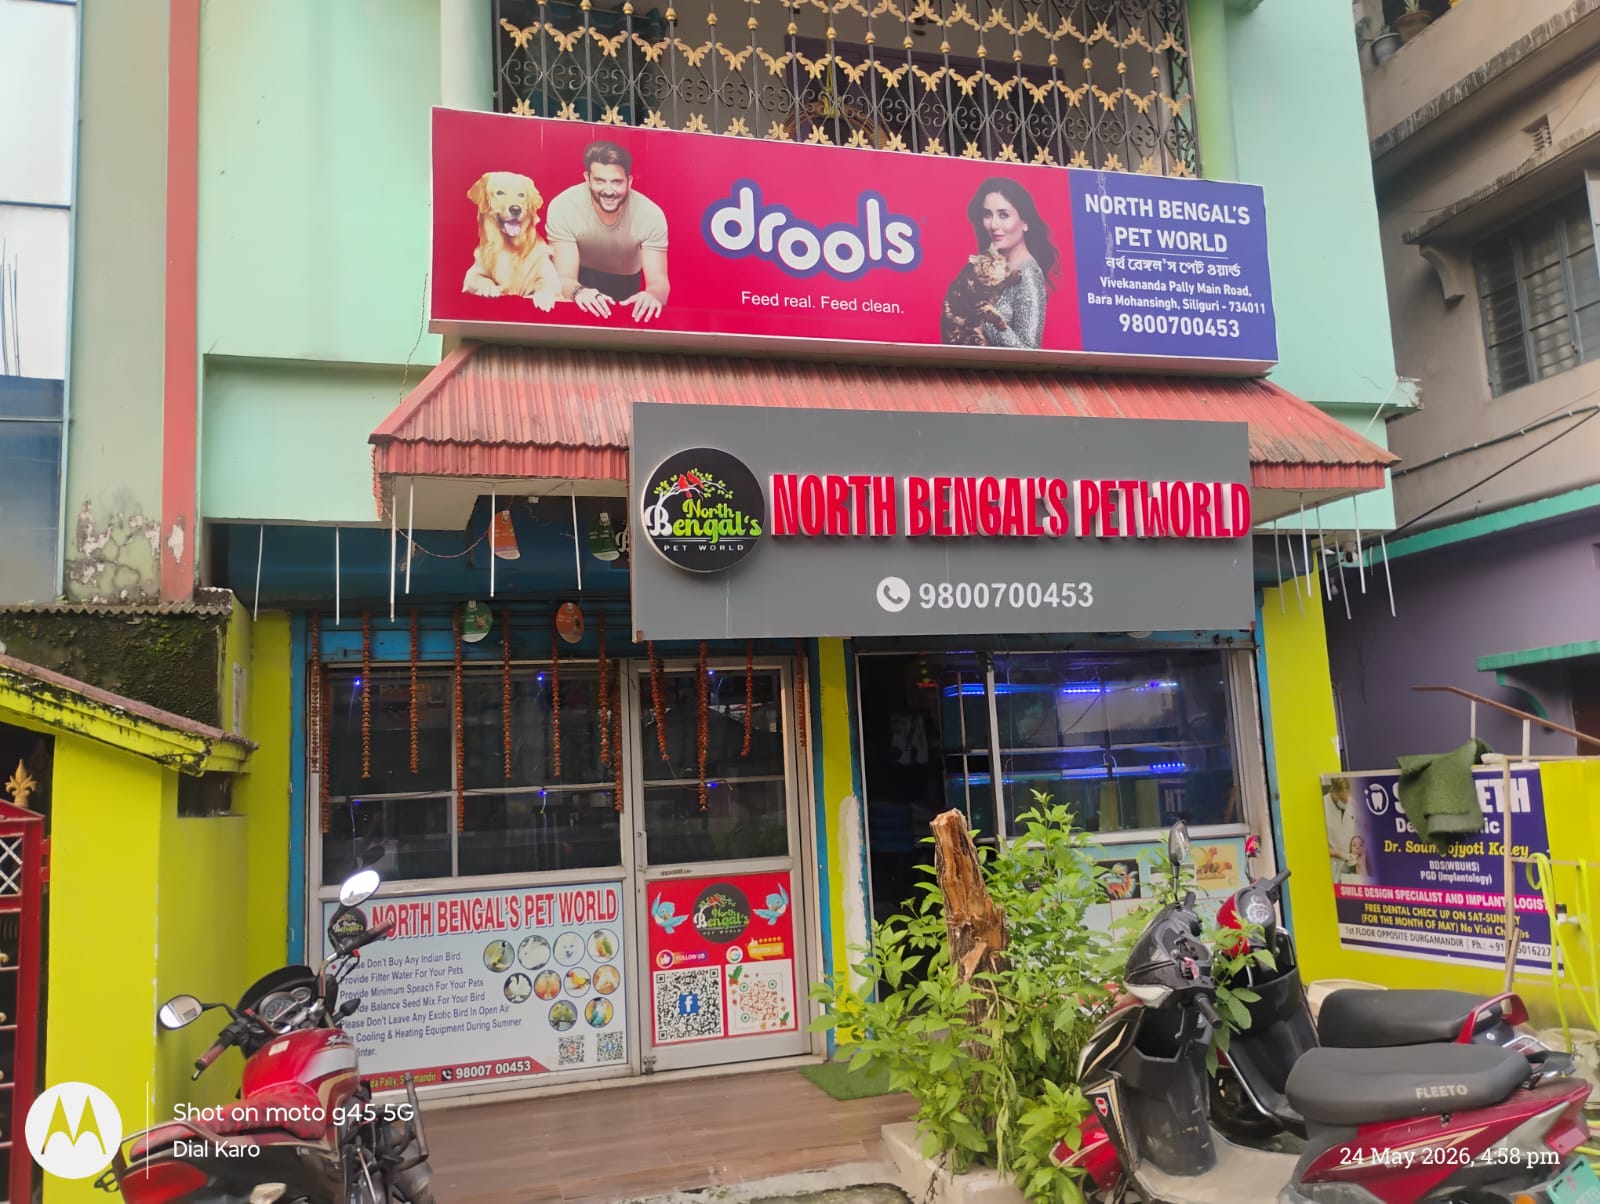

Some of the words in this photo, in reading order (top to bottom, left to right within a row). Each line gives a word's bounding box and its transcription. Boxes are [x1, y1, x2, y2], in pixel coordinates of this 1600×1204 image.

[1084, 193, 1153, 217] NORTH
[1158, 199, 1250, 225] BENGAL'S
[710, 186, 915, 274] drools
[1114, 226, 1152, 247] PET
[1157, 230, 1227, 253] WORLD
[1105, 255, 1126, 270] নর্থ
[1179, 260, 1204, 275] পেট
[1100, 276, 1167, 292] Vivekananda
[1169, 281, 1194, 296] Pally
[1197, 283, 1221, 296] Main
[1223, 284, 1252, 298] Road,
[741, 291, 779, 306] Feed
[784, 295, 815, 308] real.
[821, 296, 857, 311] Feed
[862, 299, 904, 314] clean.
[1088, 292, 1113, 305] Bara
[1115, 295, 1181, 311] Mohansingh,
[1183, 298, 1219, 313] Siliguri
[1228, 301, 1266, 314] 734011
[1118, 313, 1240, 338] 9800700453
[682, 499, 735, 518] North
[770, 475, 895, 537] NORTH
[905, 477, 1068, 538] BENGAL'S
[918, 582, 1094, 609] 9800700453
[1384, 840, 1401, 852] Dr.
[1420, 871, 1437, 881] PGD
[1341, 885, 1363, 897] SMILE
[1364, 887, 1394, 899] DESIGN
[1395, 889, 1442, 903] SPECIALIST
[1445, 893, 1464, 905] AND
[372, 903, 432, 940] NORTH
[437, 895, 519, 934] BENGAL'S
[524, 891, 555, 926] PET
[557, 889, 618, 923] WORLD
[1383, 905, 1411, 916] DENTAL
[1412, 907, 1437, 918] CHECK
[1440, 910, 1450, 919] UP
[1452, 911, 1466, 920] ON
[1361, 914, 1378, 924] (FOR
[1380, 915, 1393, 925] THE
[1395, 917, 1423, 928] MONTH
[1425, 919, 1436, 929] OF
[1438, 921, 1458, 933] MAY)
[1461, 923, 1472, 933] No
[1474, 925, 1492, 935] Visit
[1355, 928, 1376, 937] FLOOR
[1378, 930, 1408, 940] OPPOSITE
[1410, 933, 1464, 947] DURGAMANDIR
[367, 957, 387, 968] Don't
[389, 956, 403, 967] Buy
[405, 955, 419, 965] Any
[421, 952, 443, 962] Indian
[371, 972, 390, 982] Filter
[392, 971, 412, 980] Water
[415, 969, 427, 978] For
[429, 967, 445, 977] Your
[448, 966, 464, 975] Pets
[340, 989, 368, 1000] Provide
[371, 986, 405, 997] Minimum
[407, 983, 434, 994] Speach
[436, 981, 448, 990] For
[450, 979, 466, 989] Your
[468, 978, 484, 987] Pets
[371, 1001, 400, 1012] Balance
[402, 999, 420, 1008] Seed
[423, 997, 435, 1006] Mix
[437, 996, 449, 1005] For
[451, 994, 468, 1004] Your
[470, 992, 485, 1001] Bird
[367, 1017, 386, 1027] Don't
[388, 1014, 413, 1025] Leave
[413, 1013, 426, 1023] Any
[429, 1010, 451, 1020] Exotic
[453, 1007, 468, 1018] Bird
[470, 1007, 477, 1016] In
[479, 1005, 497, 1016] Open
[500, 1003, 510, 1013] Air
[356, 1032, 385, 1043] Cooling
[395, 1028, 423, 1039] Heating
[425, 1022, 464, 1035] Equipment
[466, 1020, 490, 1032] During
[492, 1018, 521, 1029] Summer
[357, 1047, 376, 1057] inter.
[456, 1064, 492, 1079] 98007
[495, 1060, 531, 1074] 00453
[1415, 1084, 1468, 1099] FLEETO
